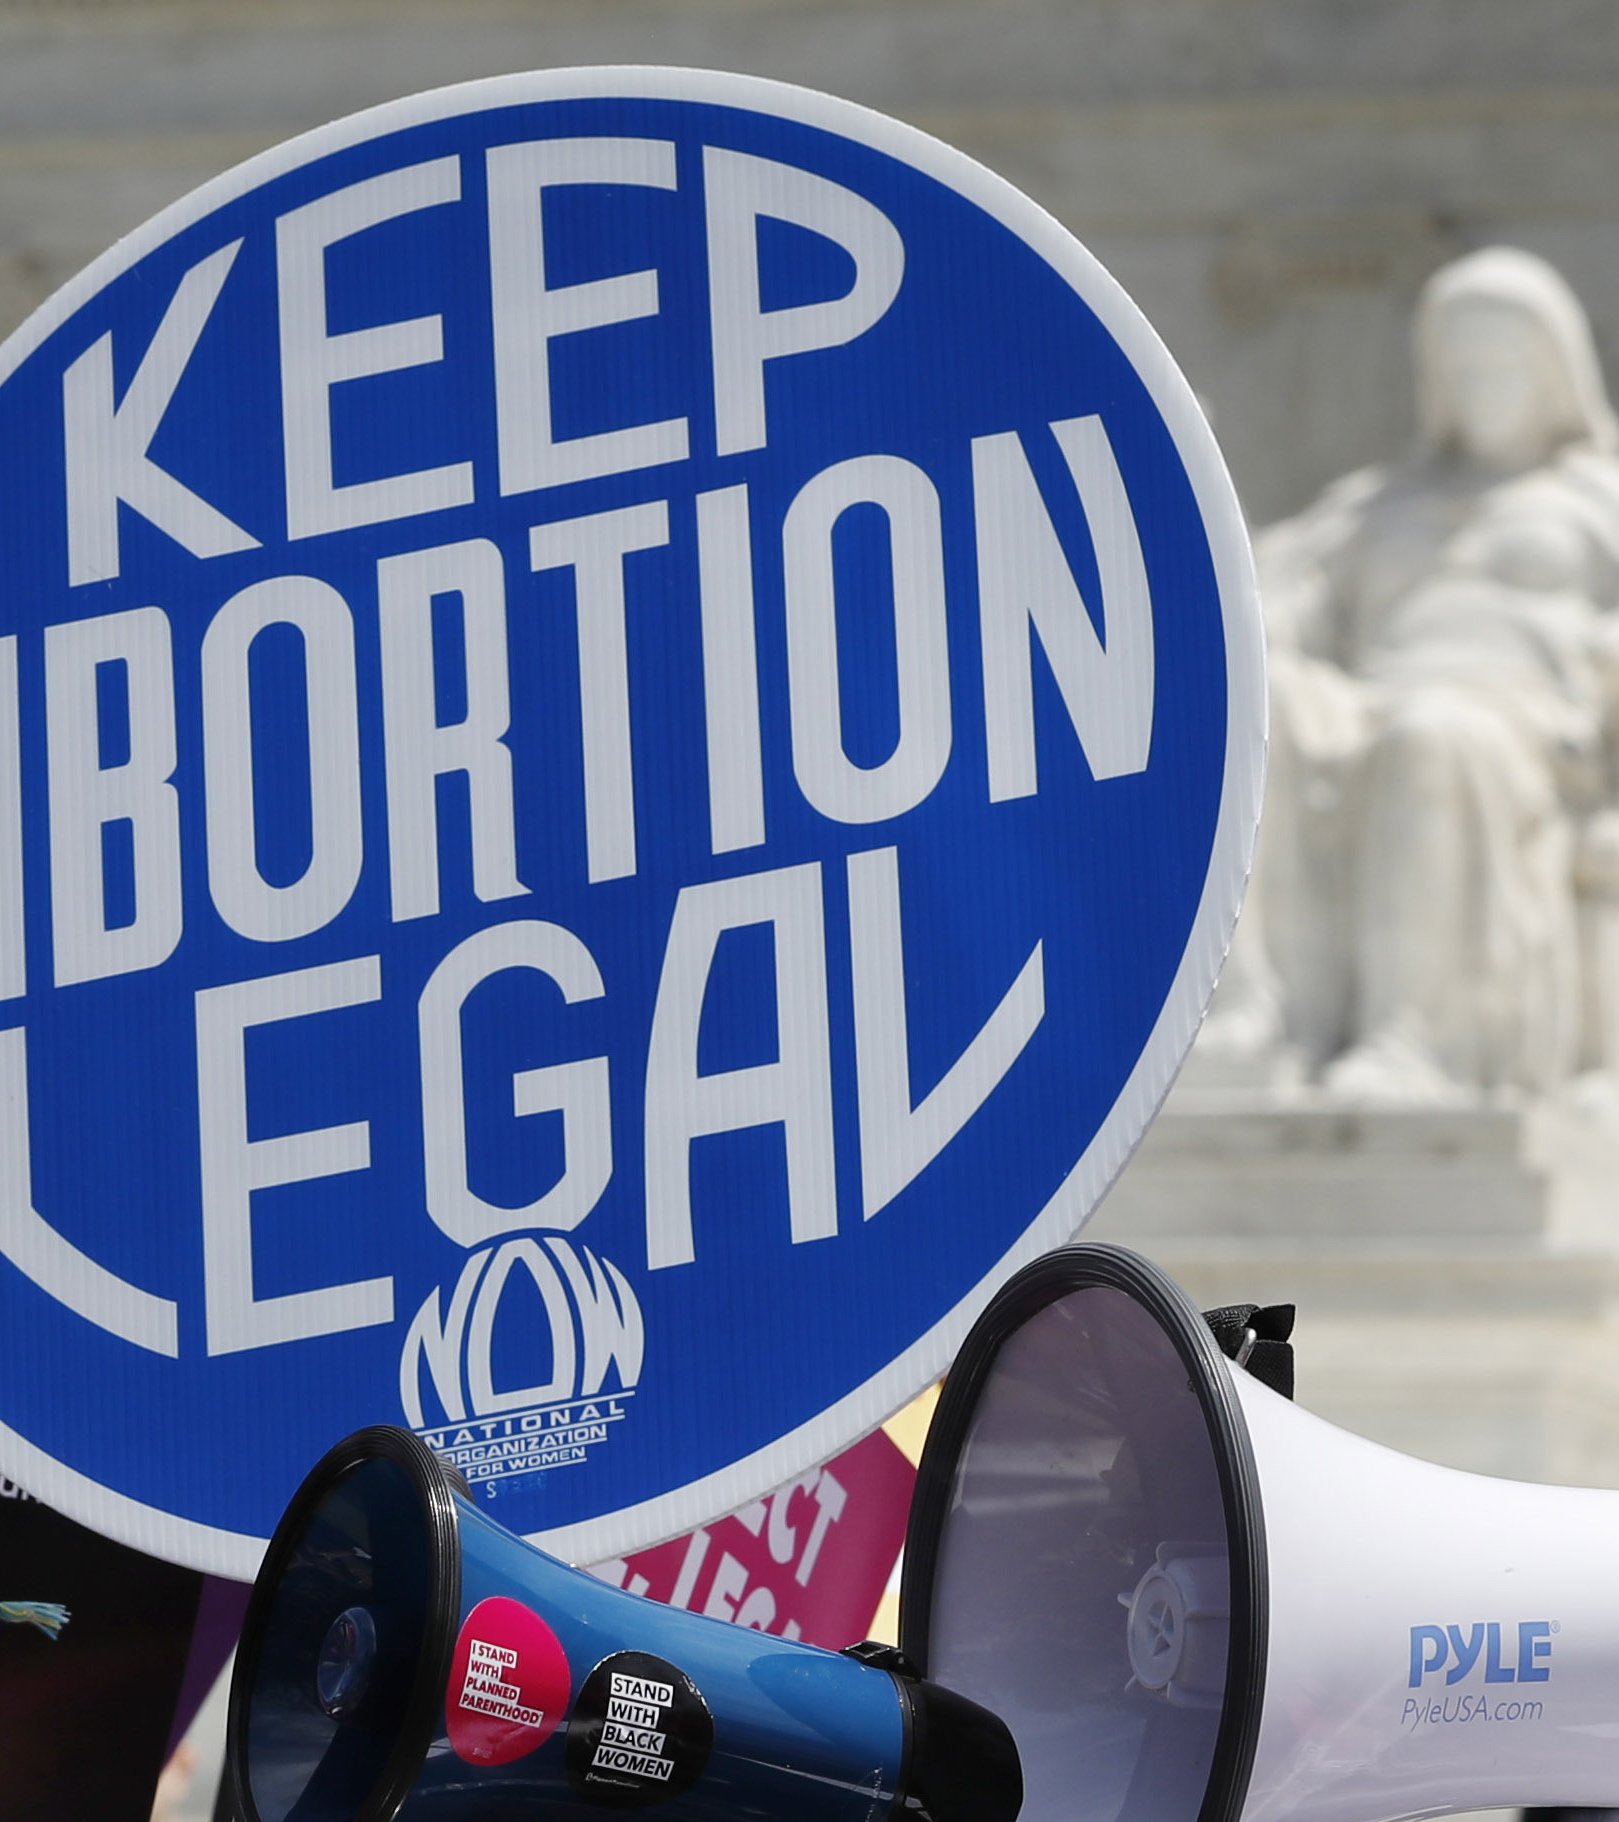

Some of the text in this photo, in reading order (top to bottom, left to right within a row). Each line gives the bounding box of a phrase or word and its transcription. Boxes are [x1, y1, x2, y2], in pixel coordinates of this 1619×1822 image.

[63, 137, 906, 587] KEEP
[400, 1236, 644, 1429] NOW
[424, 1400, 625, 1448] NATIONAL
[466, 1446, 586, 1479] FOR WOMEN
[470, 1660, 500, 1679] WITH
[472, 1643, 515, 1665] I STAND
[1408, 1621, 1551, 1688] PYLE
[466, 1677, 518, 1701] PLANNED
[614, 1676, 670, 1703] STAND
[461, 1694, 540, 1725] PARENTHOOD
[610, 1702, 656, 1725] WITH
[1401, 1695, 1543, 1733] PyleUSA.com
[604, 1727, 662, 1752] BLACK
[596, 1748, 672, 1779] WOMEN
